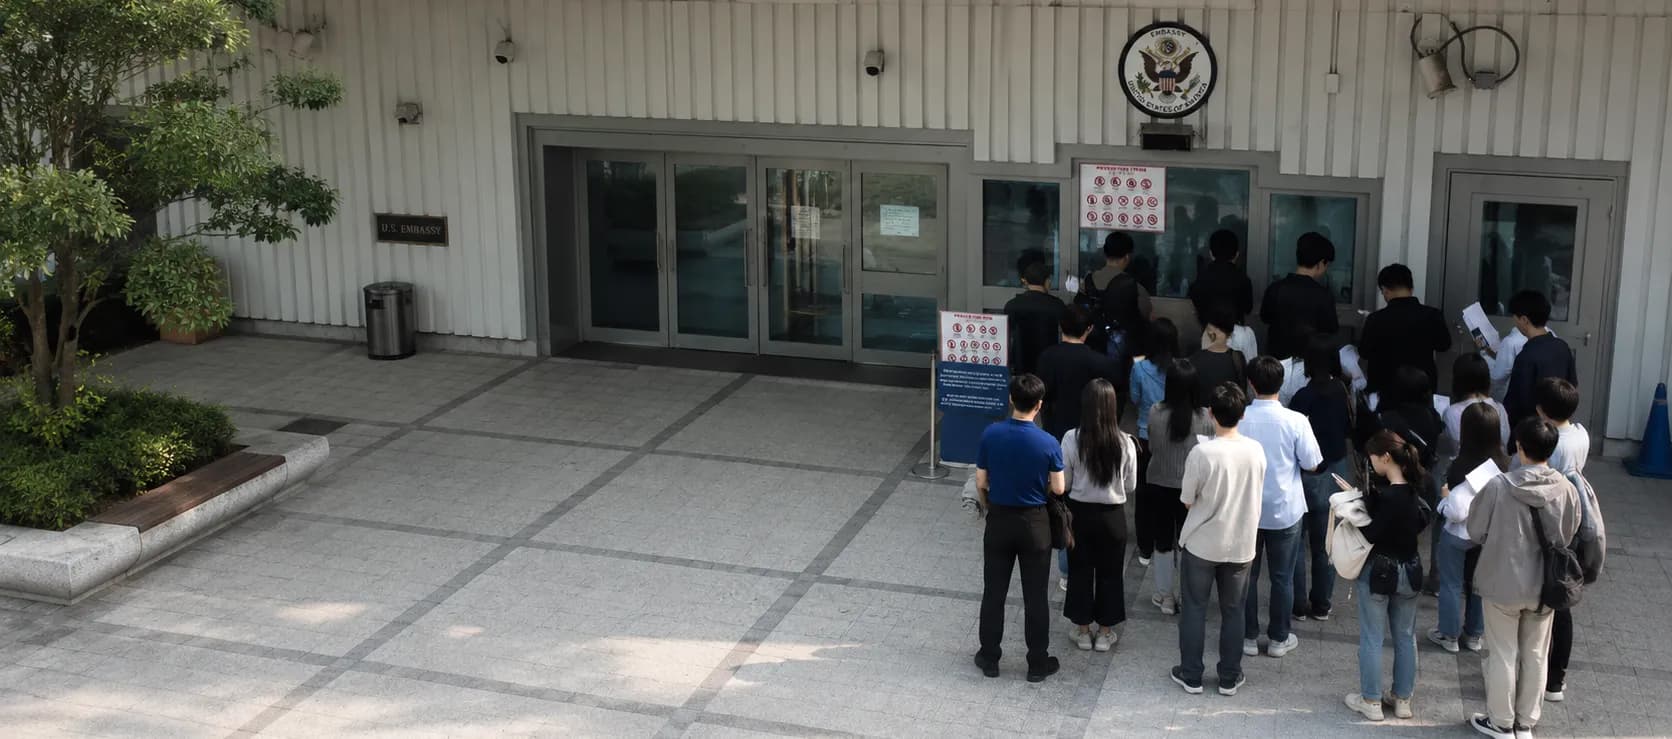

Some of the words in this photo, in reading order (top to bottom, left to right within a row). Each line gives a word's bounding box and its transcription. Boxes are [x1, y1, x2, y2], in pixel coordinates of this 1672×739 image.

[1150, 29, 1186, 37] EMBASSY
[1146, 101, 1173, 112] STATES
[401, 224, 441, 235] EMBASSY
